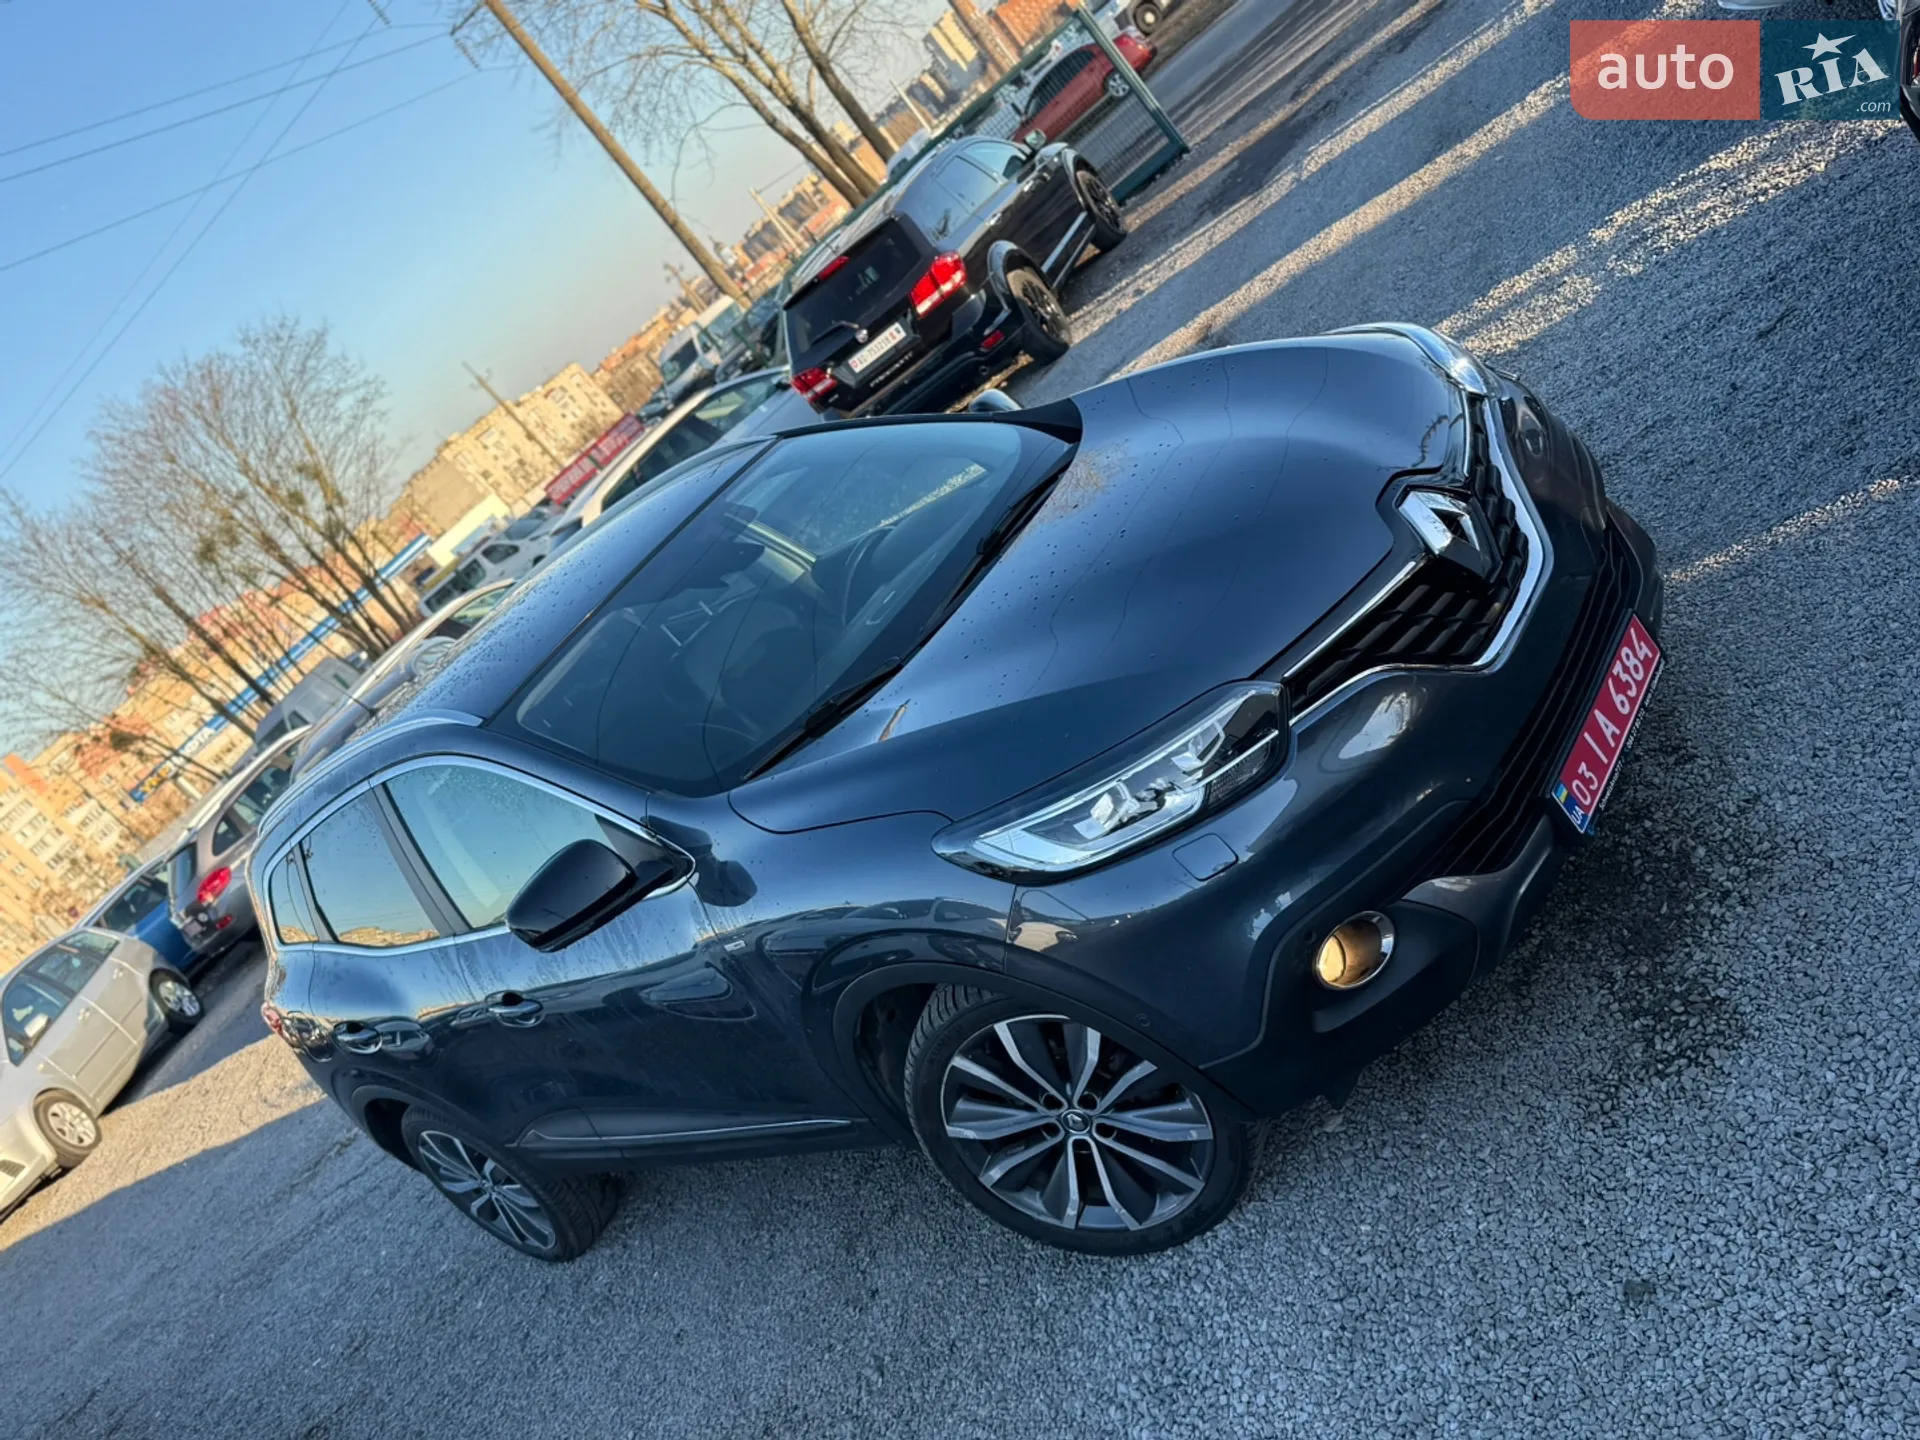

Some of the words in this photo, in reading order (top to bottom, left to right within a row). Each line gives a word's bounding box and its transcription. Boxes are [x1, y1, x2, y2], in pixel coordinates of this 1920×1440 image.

[1572, 761, 1599, 806] 03
[1608, 627, 1653, 715] 6384
[1571, 805, 1585, 825] UA
